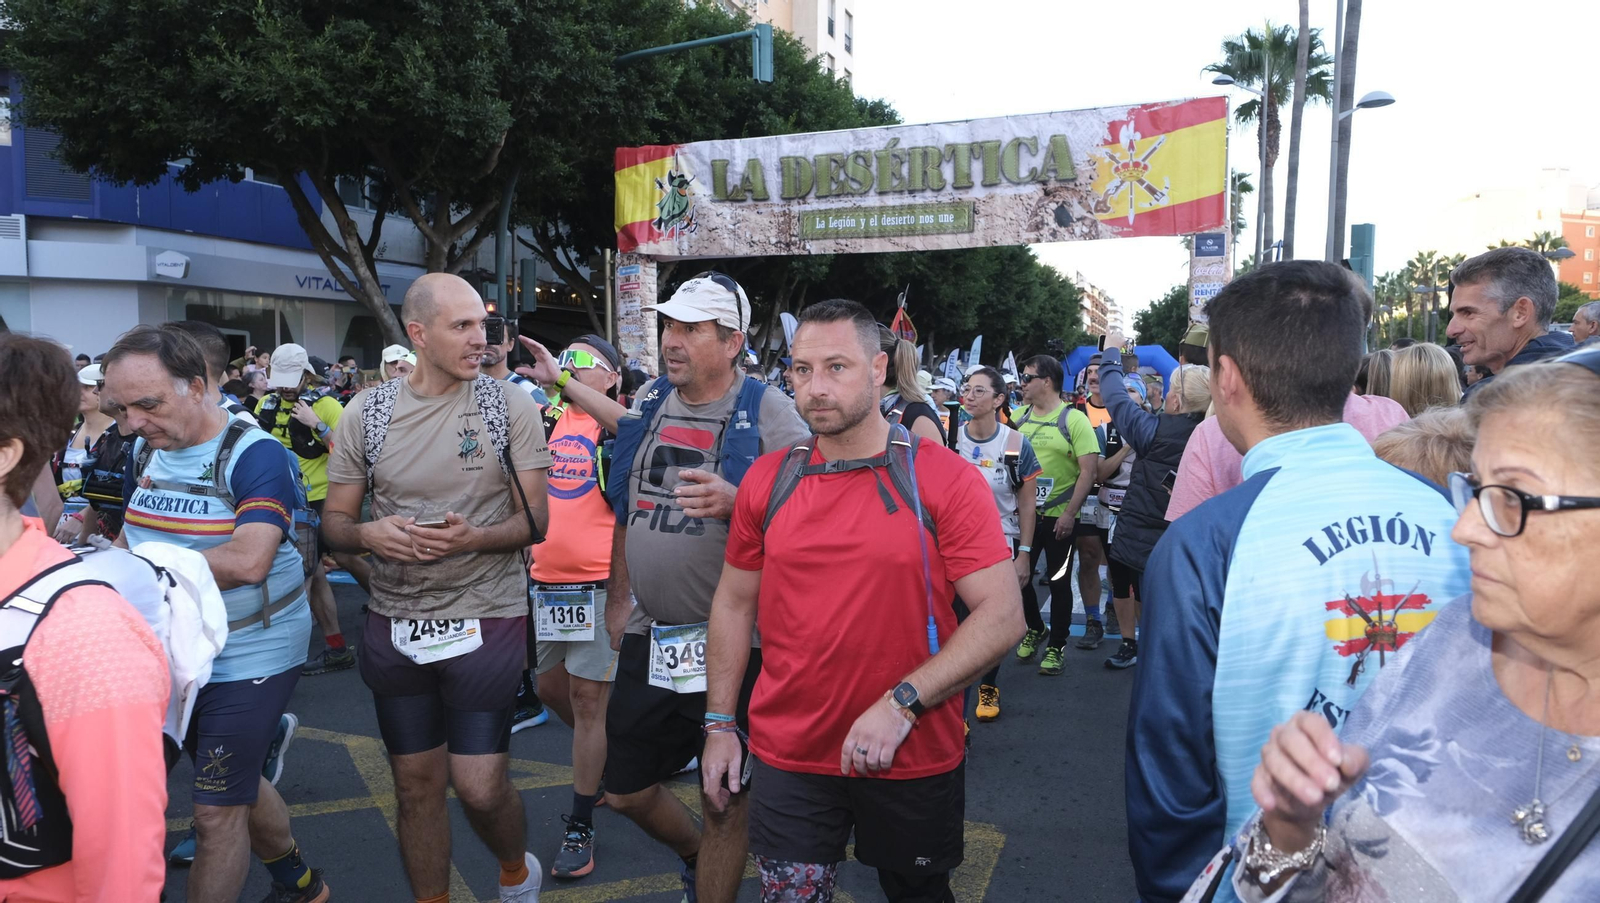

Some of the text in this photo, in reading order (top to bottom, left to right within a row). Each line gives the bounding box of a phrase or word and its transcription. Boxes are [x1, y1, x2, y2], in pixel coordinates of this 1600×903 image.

[711, 134, 1078, 201] LA DESÉRTICA
[816, 213, 954, 230] La Legión y el desierto nos une
[295, 274, 391, 297] VITALT
[137, 493, 209, 515] DESÉRTICA
[630, 500, 706, 537] FILA
[1302, 512, 1437, 566] LEGIÓN
[549, 606, 586, 624] 1316
[408, 618, 465, 642] 2499
[438, 631, 466, 641] ALEJANDRO
